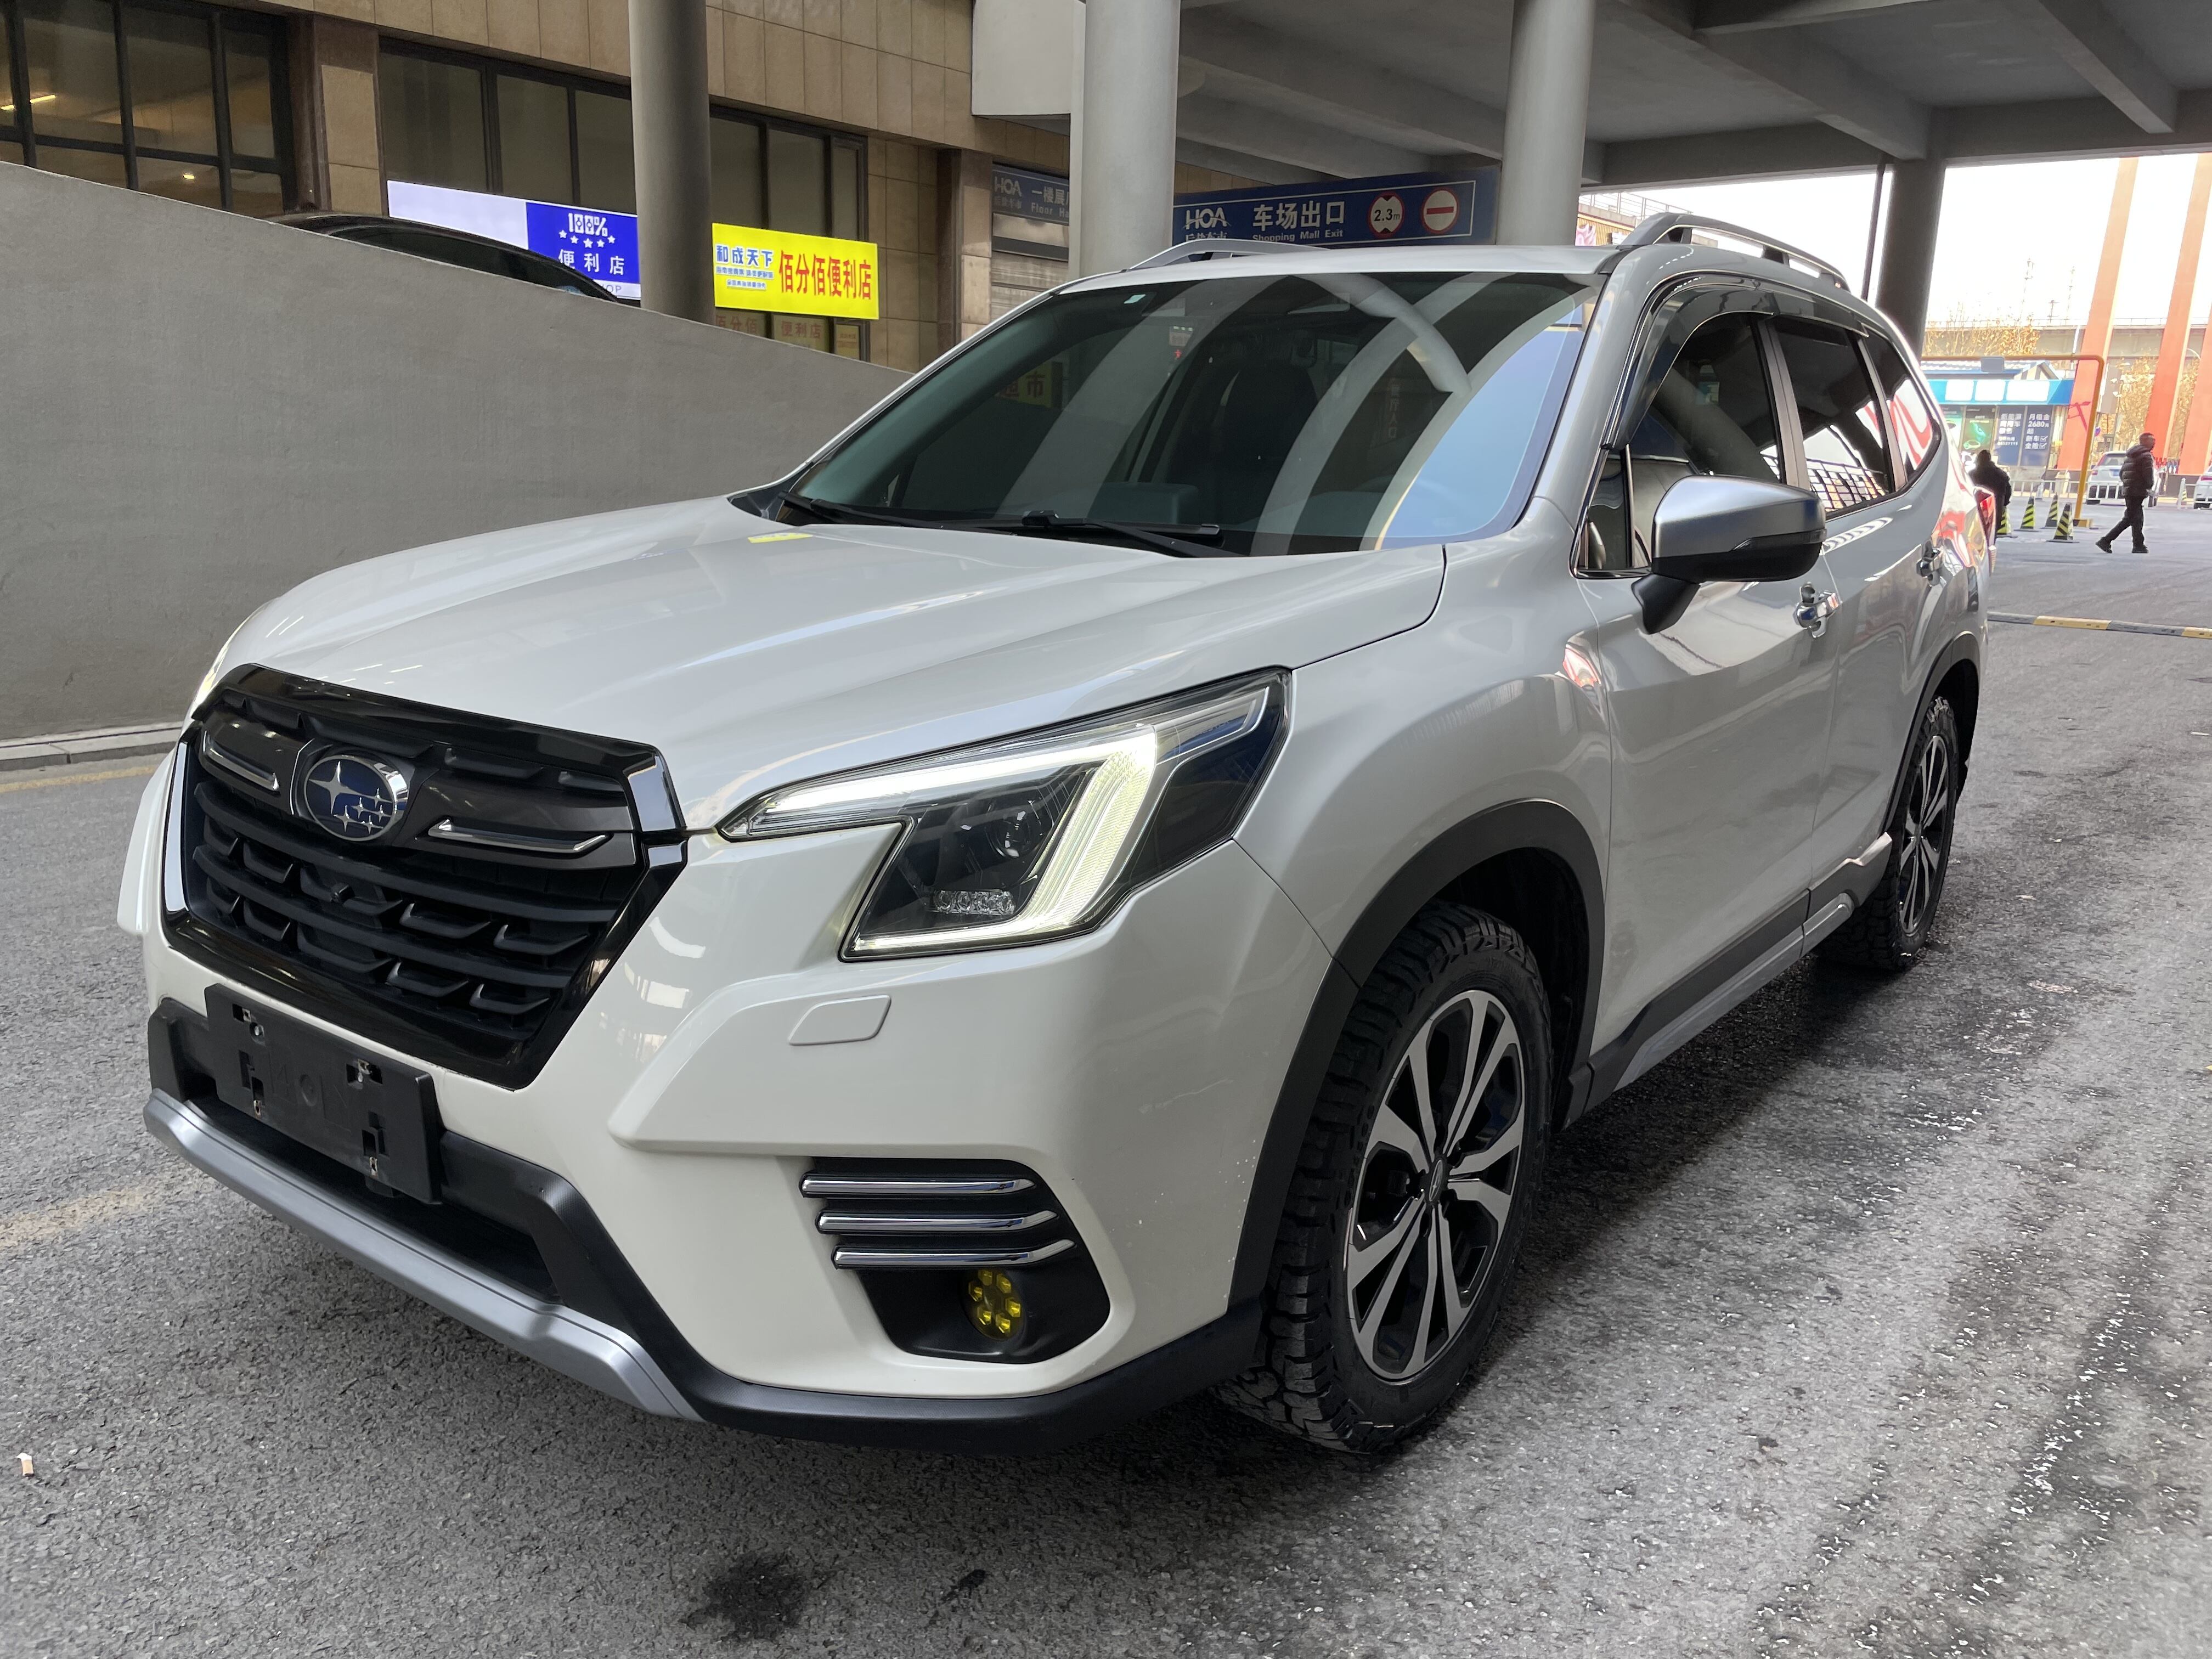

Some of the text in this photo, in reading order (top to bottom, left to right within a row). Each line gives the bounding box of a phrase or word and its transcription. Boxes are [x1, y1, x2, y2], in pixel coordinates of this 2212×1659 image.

[994, 176, 1023, 198] HOA
[1031, 202, 1053, 215] Floor
[1184, 207, 1229, 230] HOA
[1252, 200, 1345, 232] 车场出口
[1374, 208, 1401, 222] 2.3m
[568, 213, 608, 236] 100%
[1252, 229, 1344, 242] Shopping Mall Exit
[558, 249, 624, 275] 便利店
[716, 245, 773, 267] 和成天下
[779, 250, 871, 300] 佰分佰便利店
[781, 321, 821, 338] 便利店
